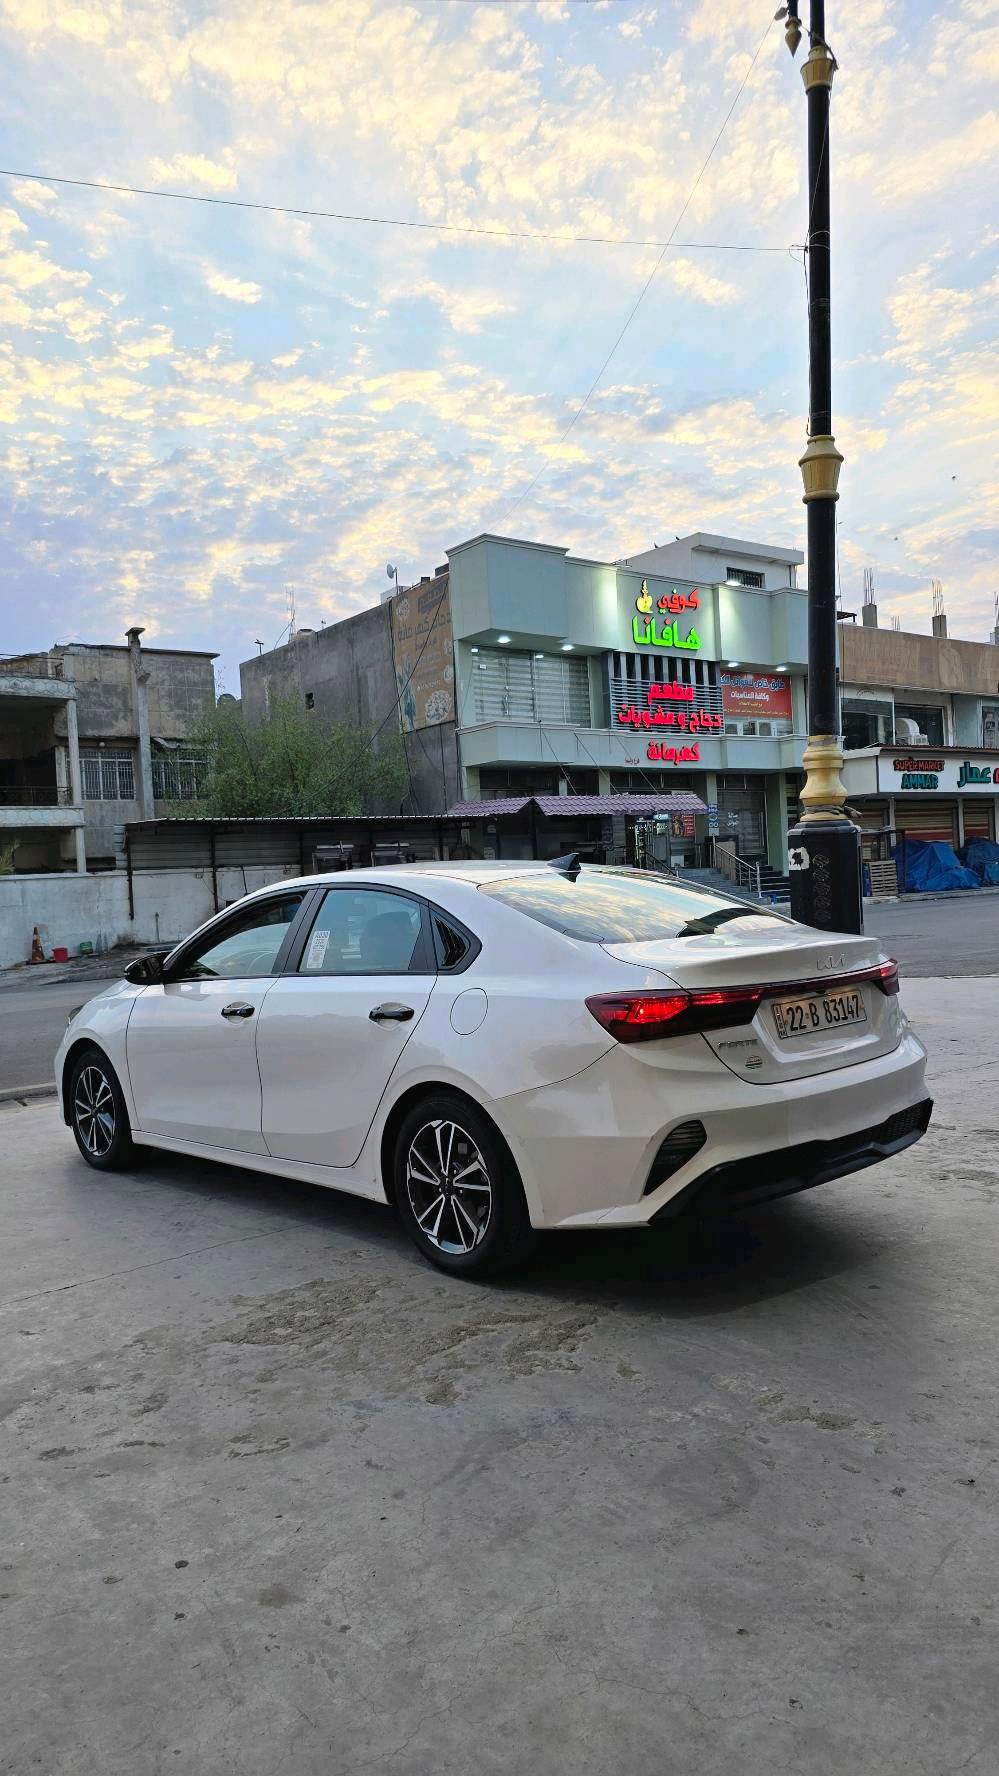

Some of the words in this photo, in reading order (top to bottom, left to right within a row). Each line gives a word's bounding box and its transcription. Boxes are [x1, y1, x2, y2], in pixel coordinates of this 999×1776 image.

[657, 586, 701, 614] كوفي
[632, 616, 702, 649] هافانا
[647, 681, 694, 705] مطعم
[618, 704, 675, 728] مشويات
[689, 708, 722, 733] دجاج
[646, 741, 700, 766] كهرمانة
[894, 758, 918, 772] SUPER
[919, 760, 945, 772] MARKET
[901, 773, 939, 789] AMMAR
[957, 761, 992, 788] عمار
[786, 1004, 807, 1032] 22
[808, 1003, 820, 1027] B
[823, 995, 860, 1024] 83147
